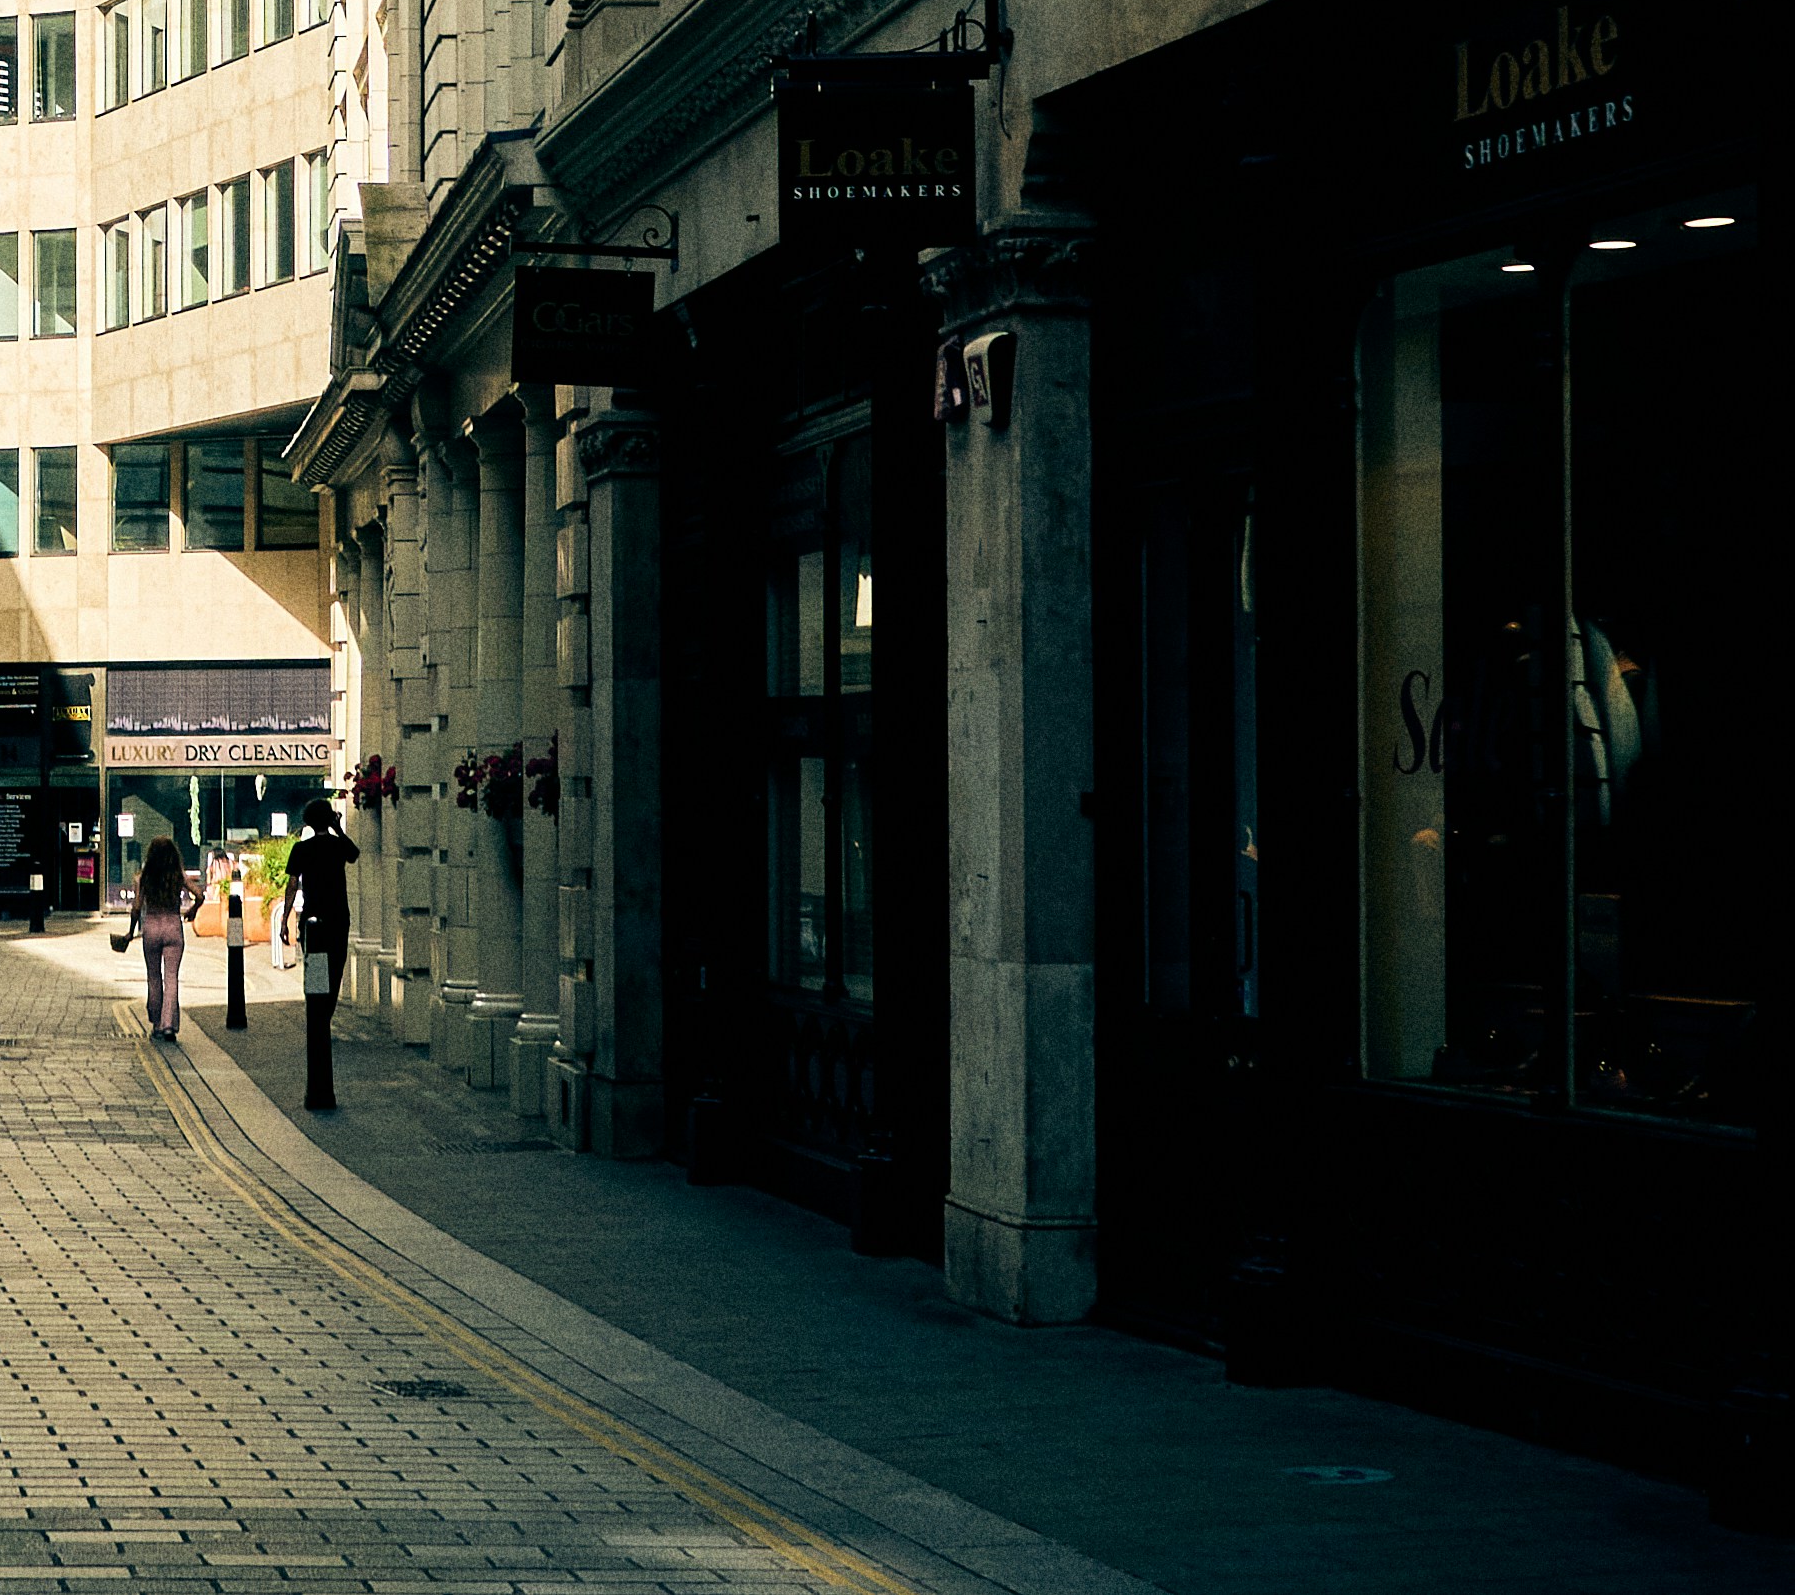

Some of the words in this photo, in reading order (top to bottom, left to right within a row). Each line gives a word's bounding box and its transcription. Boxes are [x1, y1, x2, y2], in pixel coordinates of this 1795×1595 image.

[1454, 5, 1619, 122] Loake
[1464, 95, 1635, 170] SHOEMAKERS
[794, 137, 960, 178] Loake
[793, 184, 962, 200] SHOEMAKERS
[111, 745, 179, 761] LUXURY
[185, 744, 222, 761] DRY
[228, 744, 329, 760] CLEANING
